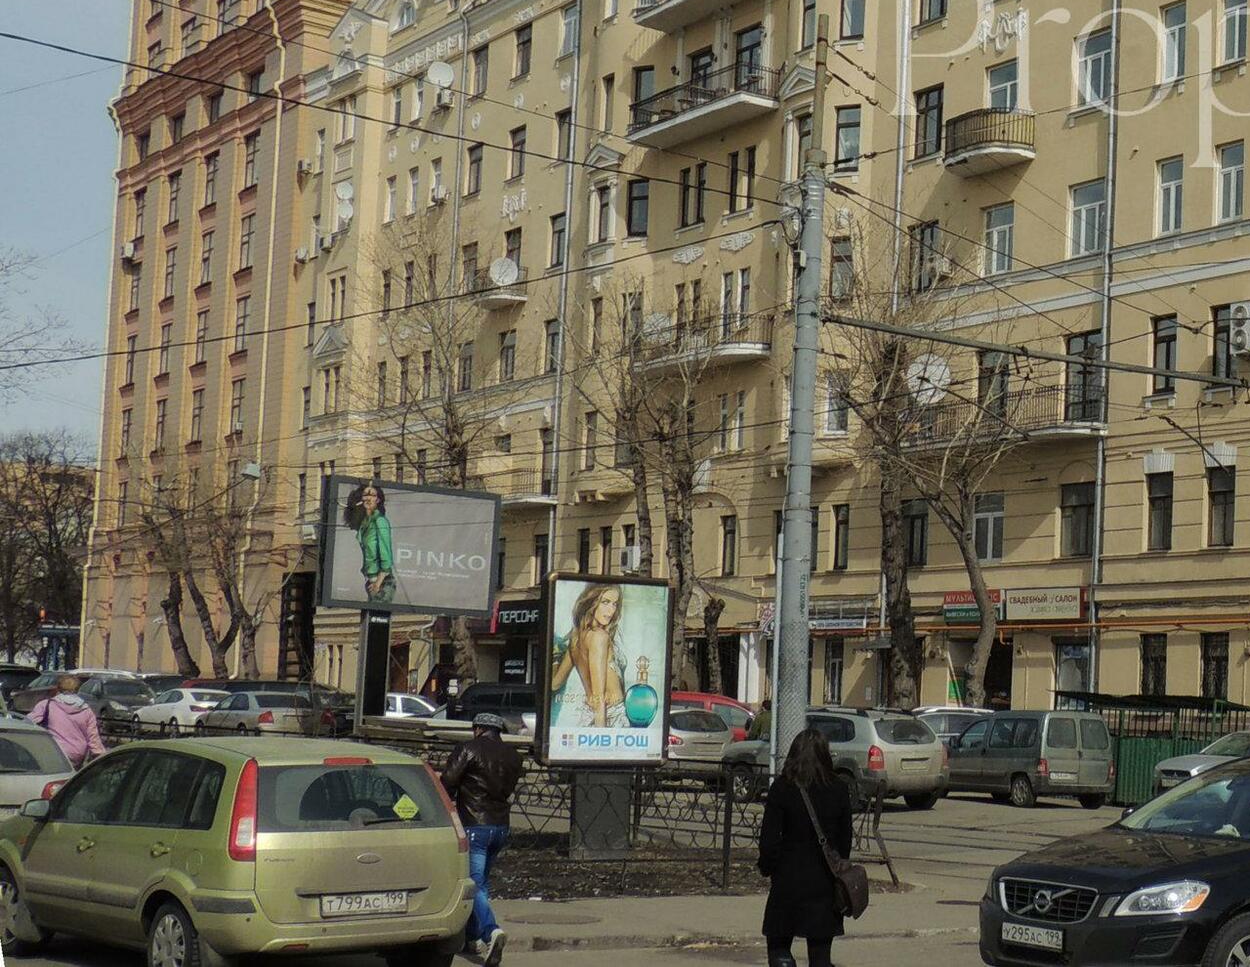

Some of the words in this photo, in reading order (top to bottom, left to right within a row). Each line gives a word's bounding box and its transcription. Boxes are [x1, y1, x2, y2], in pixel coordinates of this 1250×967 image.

[396, 548, 486, 572] PINKO
[1009, 594, 1047, 605] СВАДЕБНЫЙ
[1055, 594, 1078, 603] САЛОН
[578, 734, 611, 747] РИВ
[615, 734, 649, 747] ГОШ
